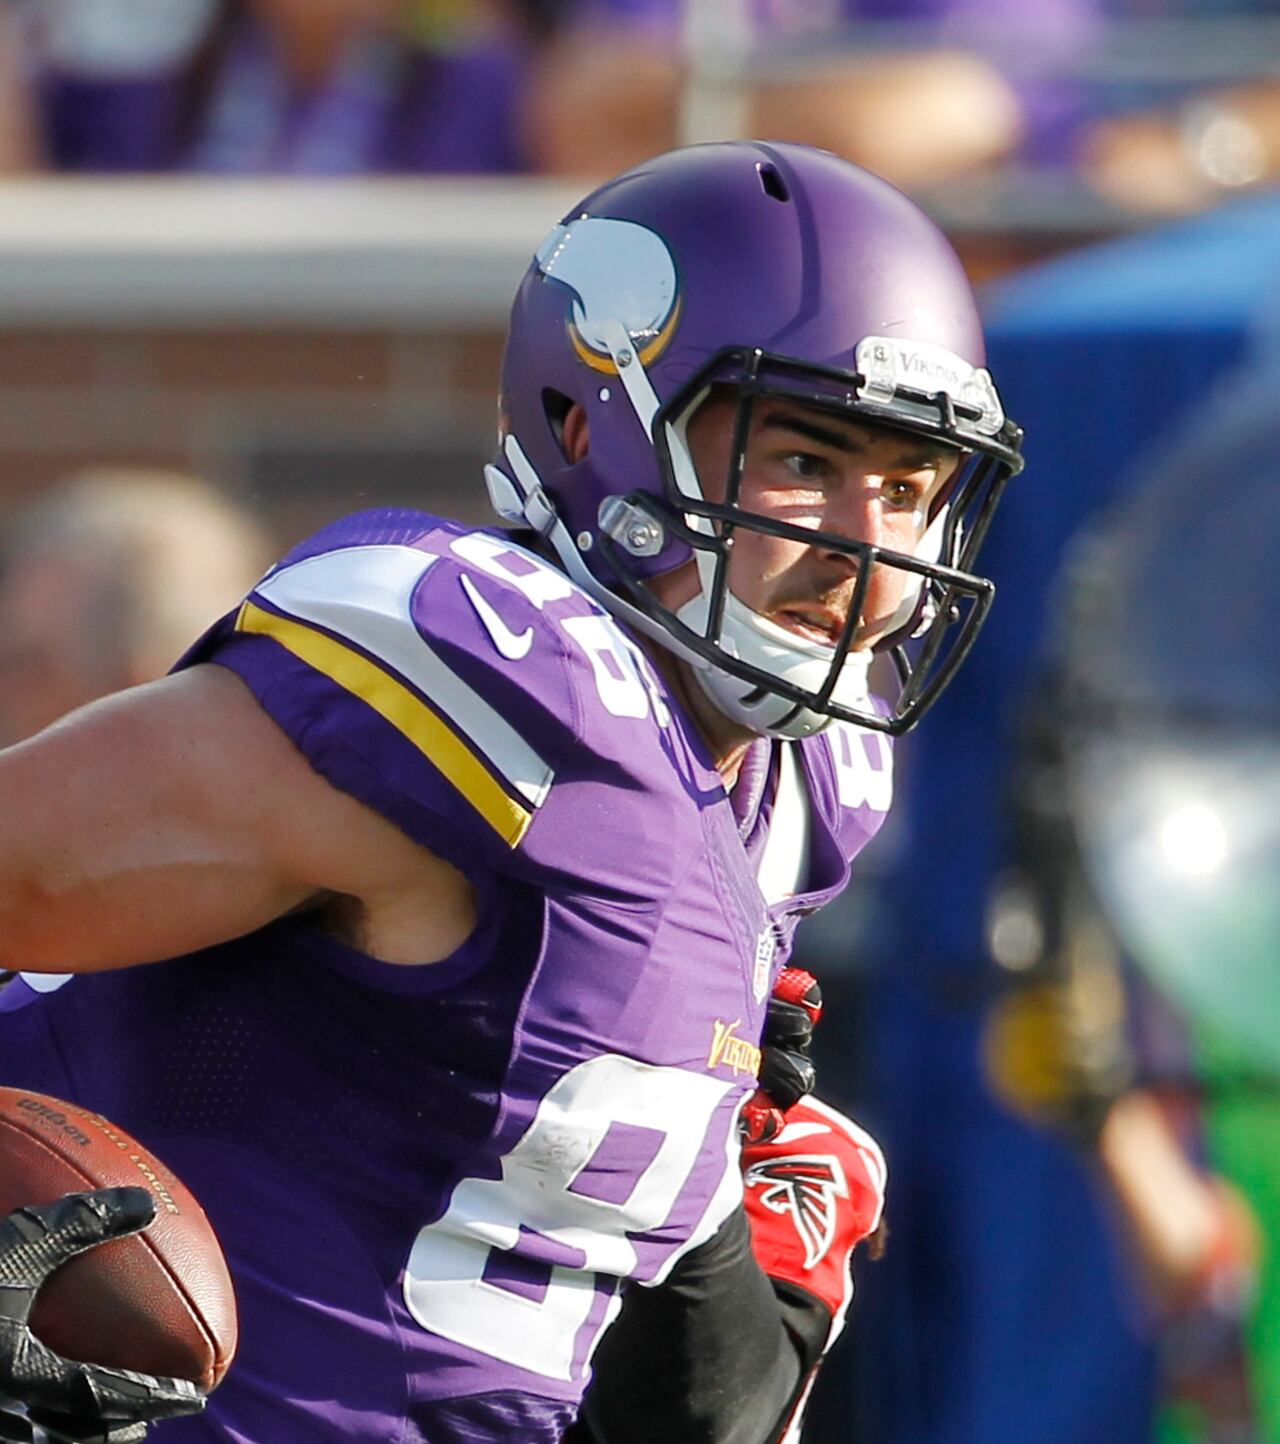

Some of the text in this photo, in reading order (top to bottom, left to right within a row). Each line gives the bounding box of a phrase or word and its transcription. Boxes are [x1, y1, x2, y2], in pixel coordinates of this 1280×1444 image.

[16, 1099, 91, 1147] Wilson
[130, 1154, 180, 1215] LEAGUE
[403, 1053, 755, 1382] 8
